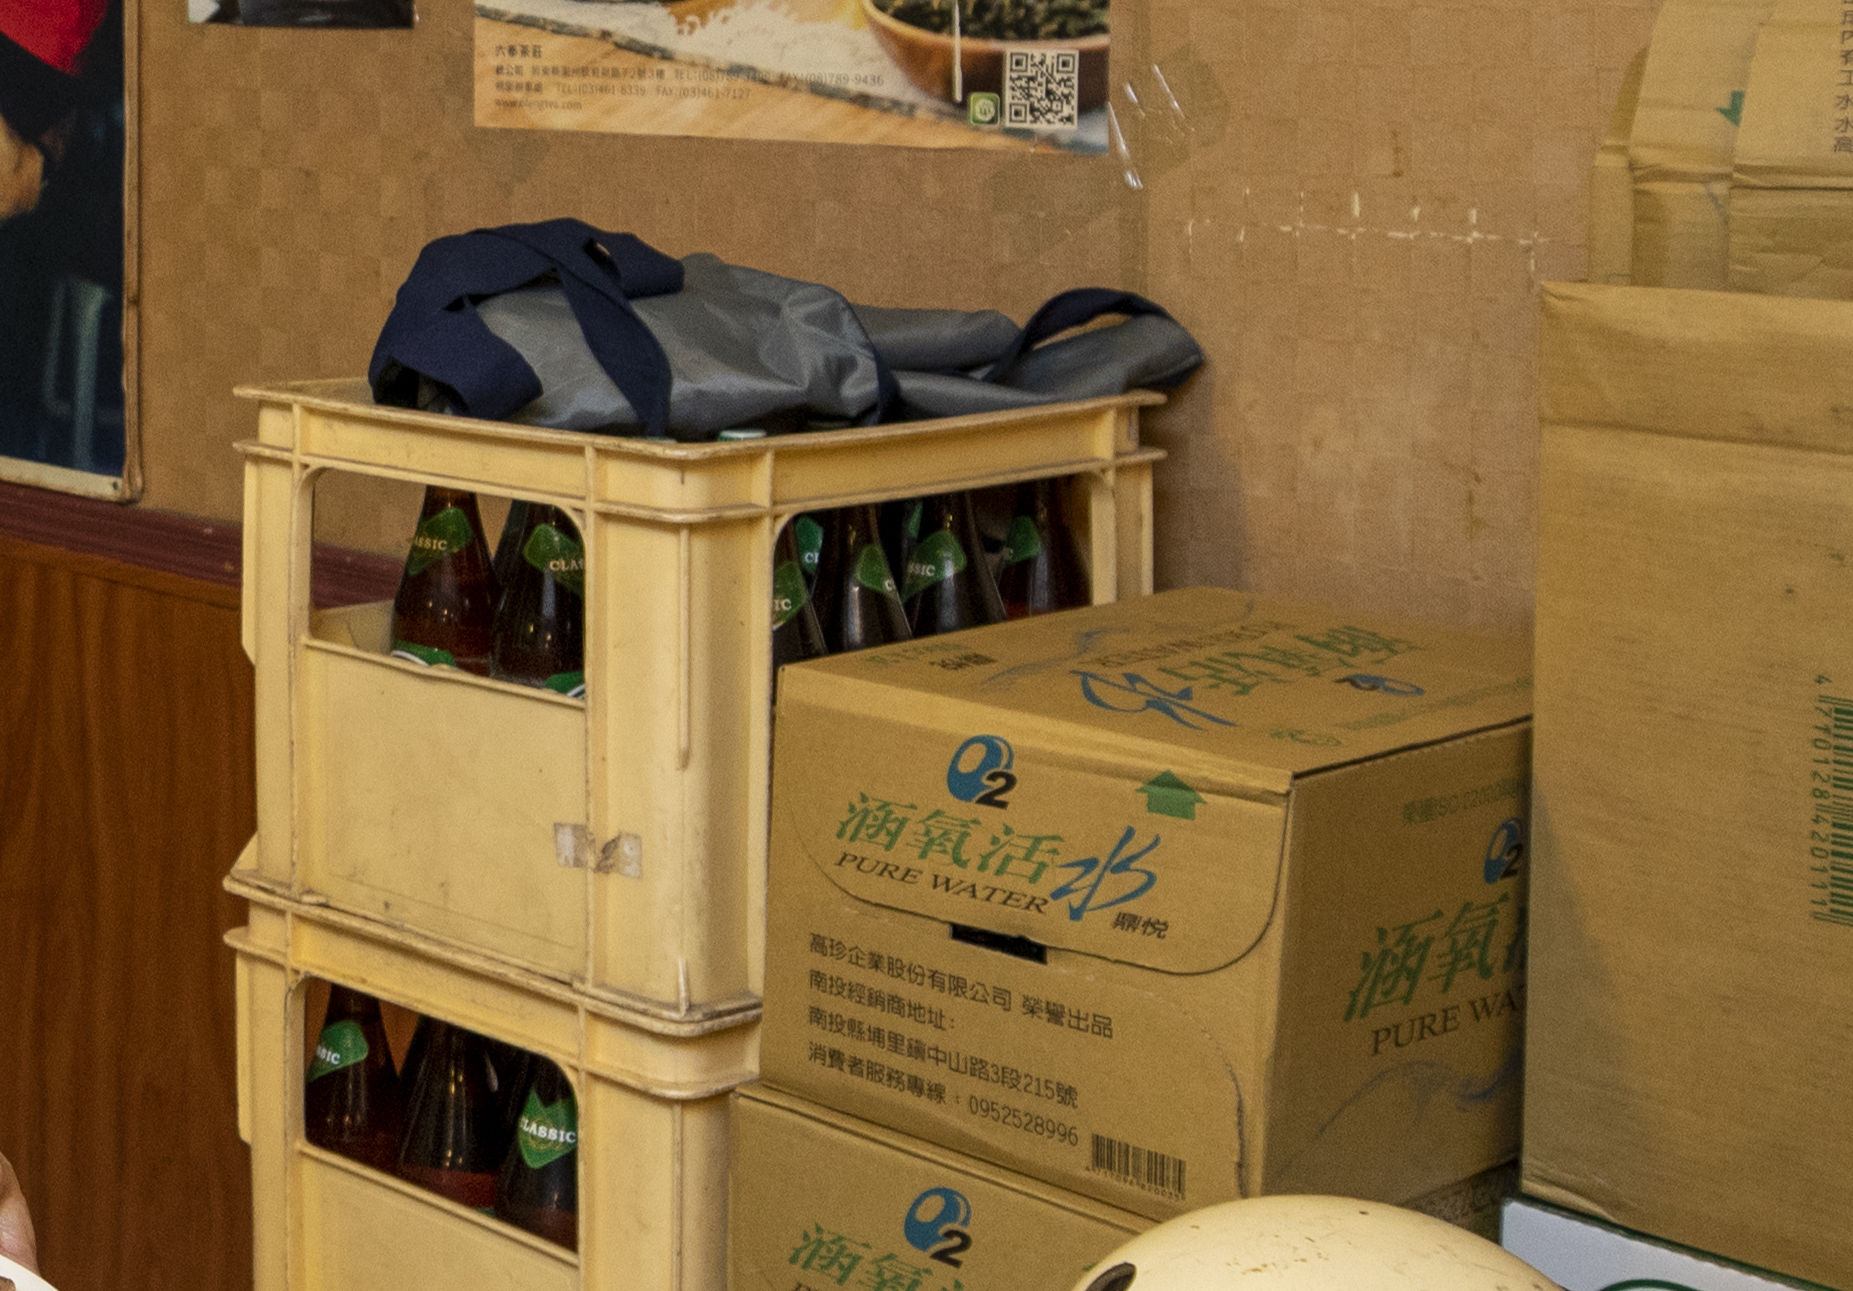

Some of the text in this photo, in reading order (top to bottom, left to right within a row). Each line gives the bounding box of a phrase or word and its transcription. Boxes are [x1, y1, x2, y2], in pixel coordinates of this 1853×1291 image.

[834, 852, 1050, 915] PURE WATER
[836, 791, 1162, 922] 涵氧活水
[808, 932, 1114, 1039] 高珍企業股份有限公司 榮譽出品
[1370, 983, 1526, 1057] PURE WA
[808, 1005, 1079, 1109] 南投縣埔里鎮中山路3段215號
[518, 1115, 578, 1145] CLASSIC
[968, 1093, 1080, 1147] 0952528996
